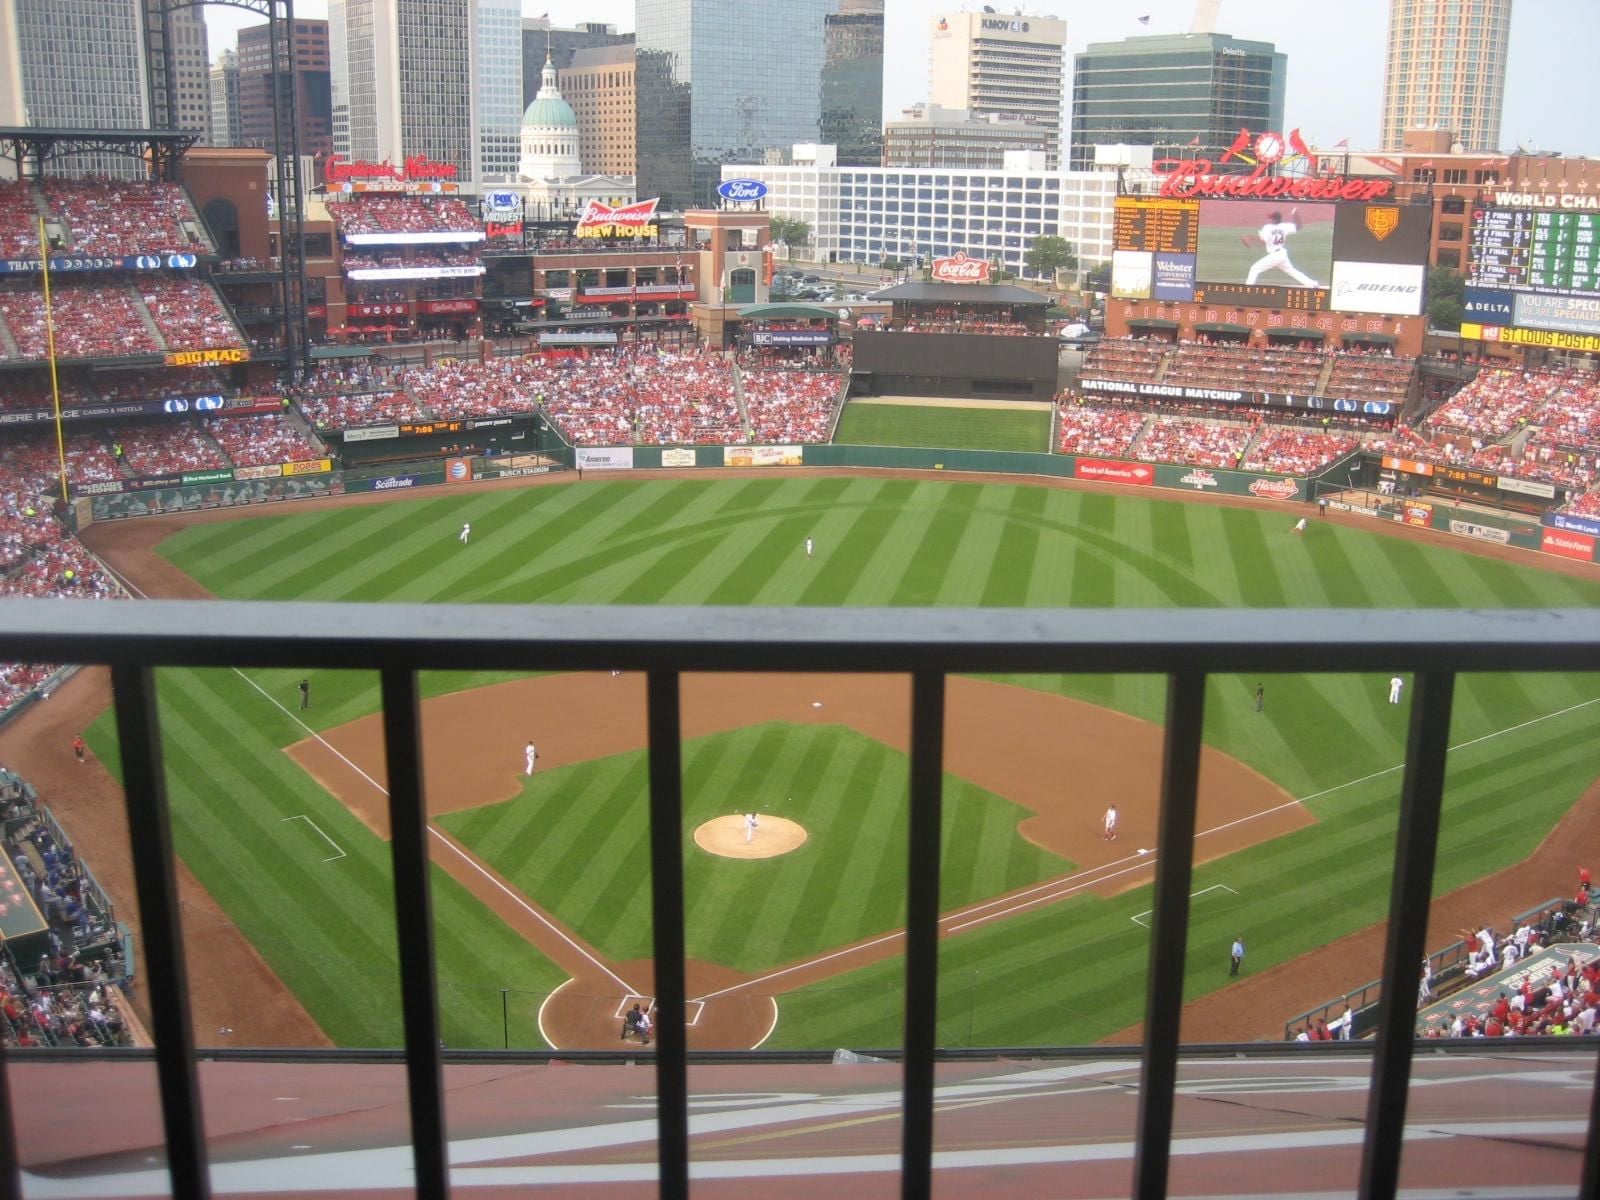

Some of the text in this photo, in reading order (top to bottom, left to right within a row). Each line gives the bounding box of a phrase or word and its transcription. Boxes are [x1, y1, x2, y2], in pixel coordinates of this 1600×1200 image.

[982, 18, 1009, 30] KMOV
[1152, 158, 1394, 200] Budweiser
[728, 182, 759, 197] Ford
[494, 194, 514, 202] FOX
[1495, 192, 1557, 206] WORLD
[484, 212, 524, 222] MIDWEST
[577, 206, 657, 224] Budweiser
[576, 225, 657, 238] BREW HOUSE
[8, 260, 44, 271] THAT'S
[1156, 260, 1193, 272] Webster
[1357, 283, 1418, 294] BOEING
[1522, 295, 1544, 306] YOU
[1545, 297, 1563, 308] ARE
[1476, 303, 1510, 313] DELTA
[1144, 306, 1148, 318] 1
[1157, 308, 1164, 320] 2
[1173, 308, 1180, 320] 6
[1189, 310, 1196, 321] 9
[1206, 310, 1217, 322] 10
[1226, 312, 1238, 324] 14
[1246, 313, 1259, 325] 17
[1268, 314, 1283, 327] 20
[1291, 316, 1307, 328] 24
[1316, 318, 1332, 330] 42
[1341, 319, 1357, 332] 45
[1366, 320, 1383, 333] 85
[1503, 328, 1518, 341] ST.
[1521, 329, 1553, 345] LOUIS
[174, 350, 242, 365] BIG MAC
[1081, 380, 1242, 401] NATIONAL LEAGUE MATCHUP
[416, 426, 433, 434] 7:06
[475, 420, 493, 428] JIMMY
[292, 461, 321, 471] DOBBS
[585, 456, 611, 464] Ameren
[523, 466, 550, 474] STADIUM
[1081, 466, 1098, 474] Bank
[1105, 468, 1131, 478] America
[1448, 470, 1466, 480] 7:06
[199, 473, 219, 481] National
[375, 477, 413, 489] Scottrade
[1329, 500, 1377, 516] BUSCH STADIUM
[1405, 500, 1432, 511] STLFORD
[1566, 522, 1599, 534] Merrill Lynch
